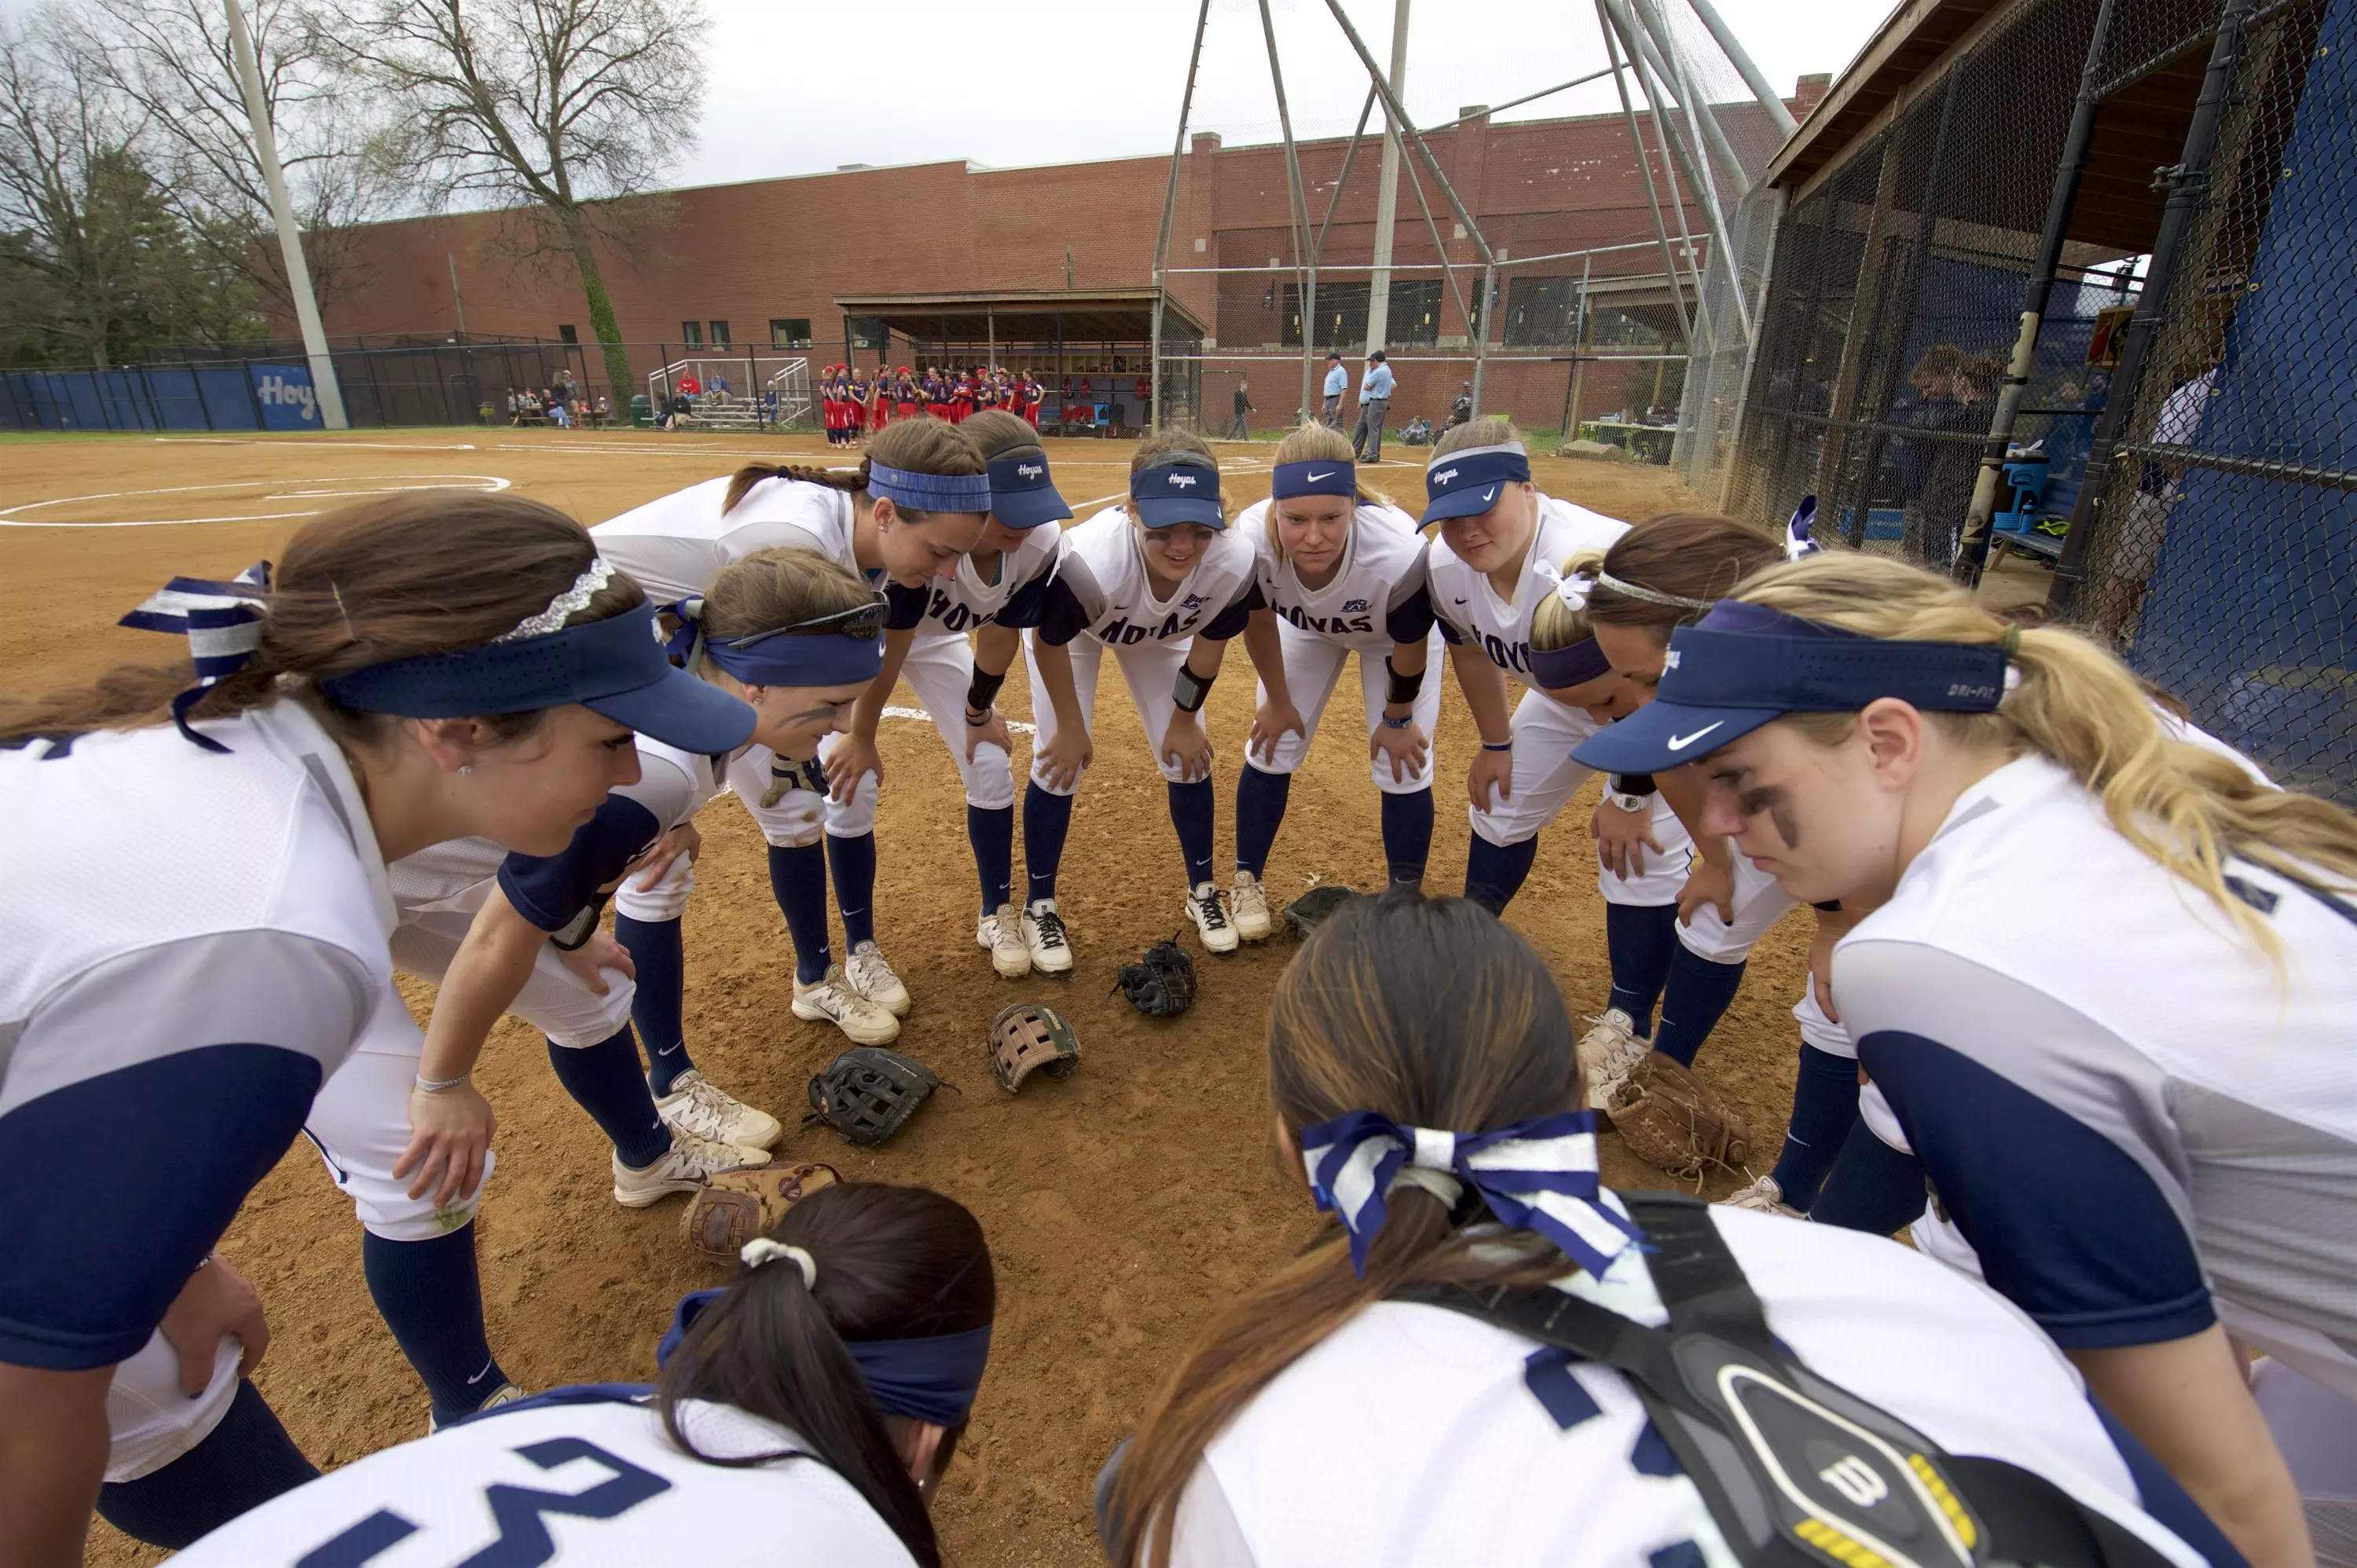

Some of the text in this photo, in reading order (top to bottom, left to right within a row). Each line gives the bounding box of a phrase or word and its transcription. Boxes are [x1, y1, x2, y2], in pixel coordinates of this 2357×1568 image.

[1017, 463, 1043, 480] Hoyas
[1434, 468, 1459, 485] Hoyas
[1168, 473, 1197, 489] Hoyas
